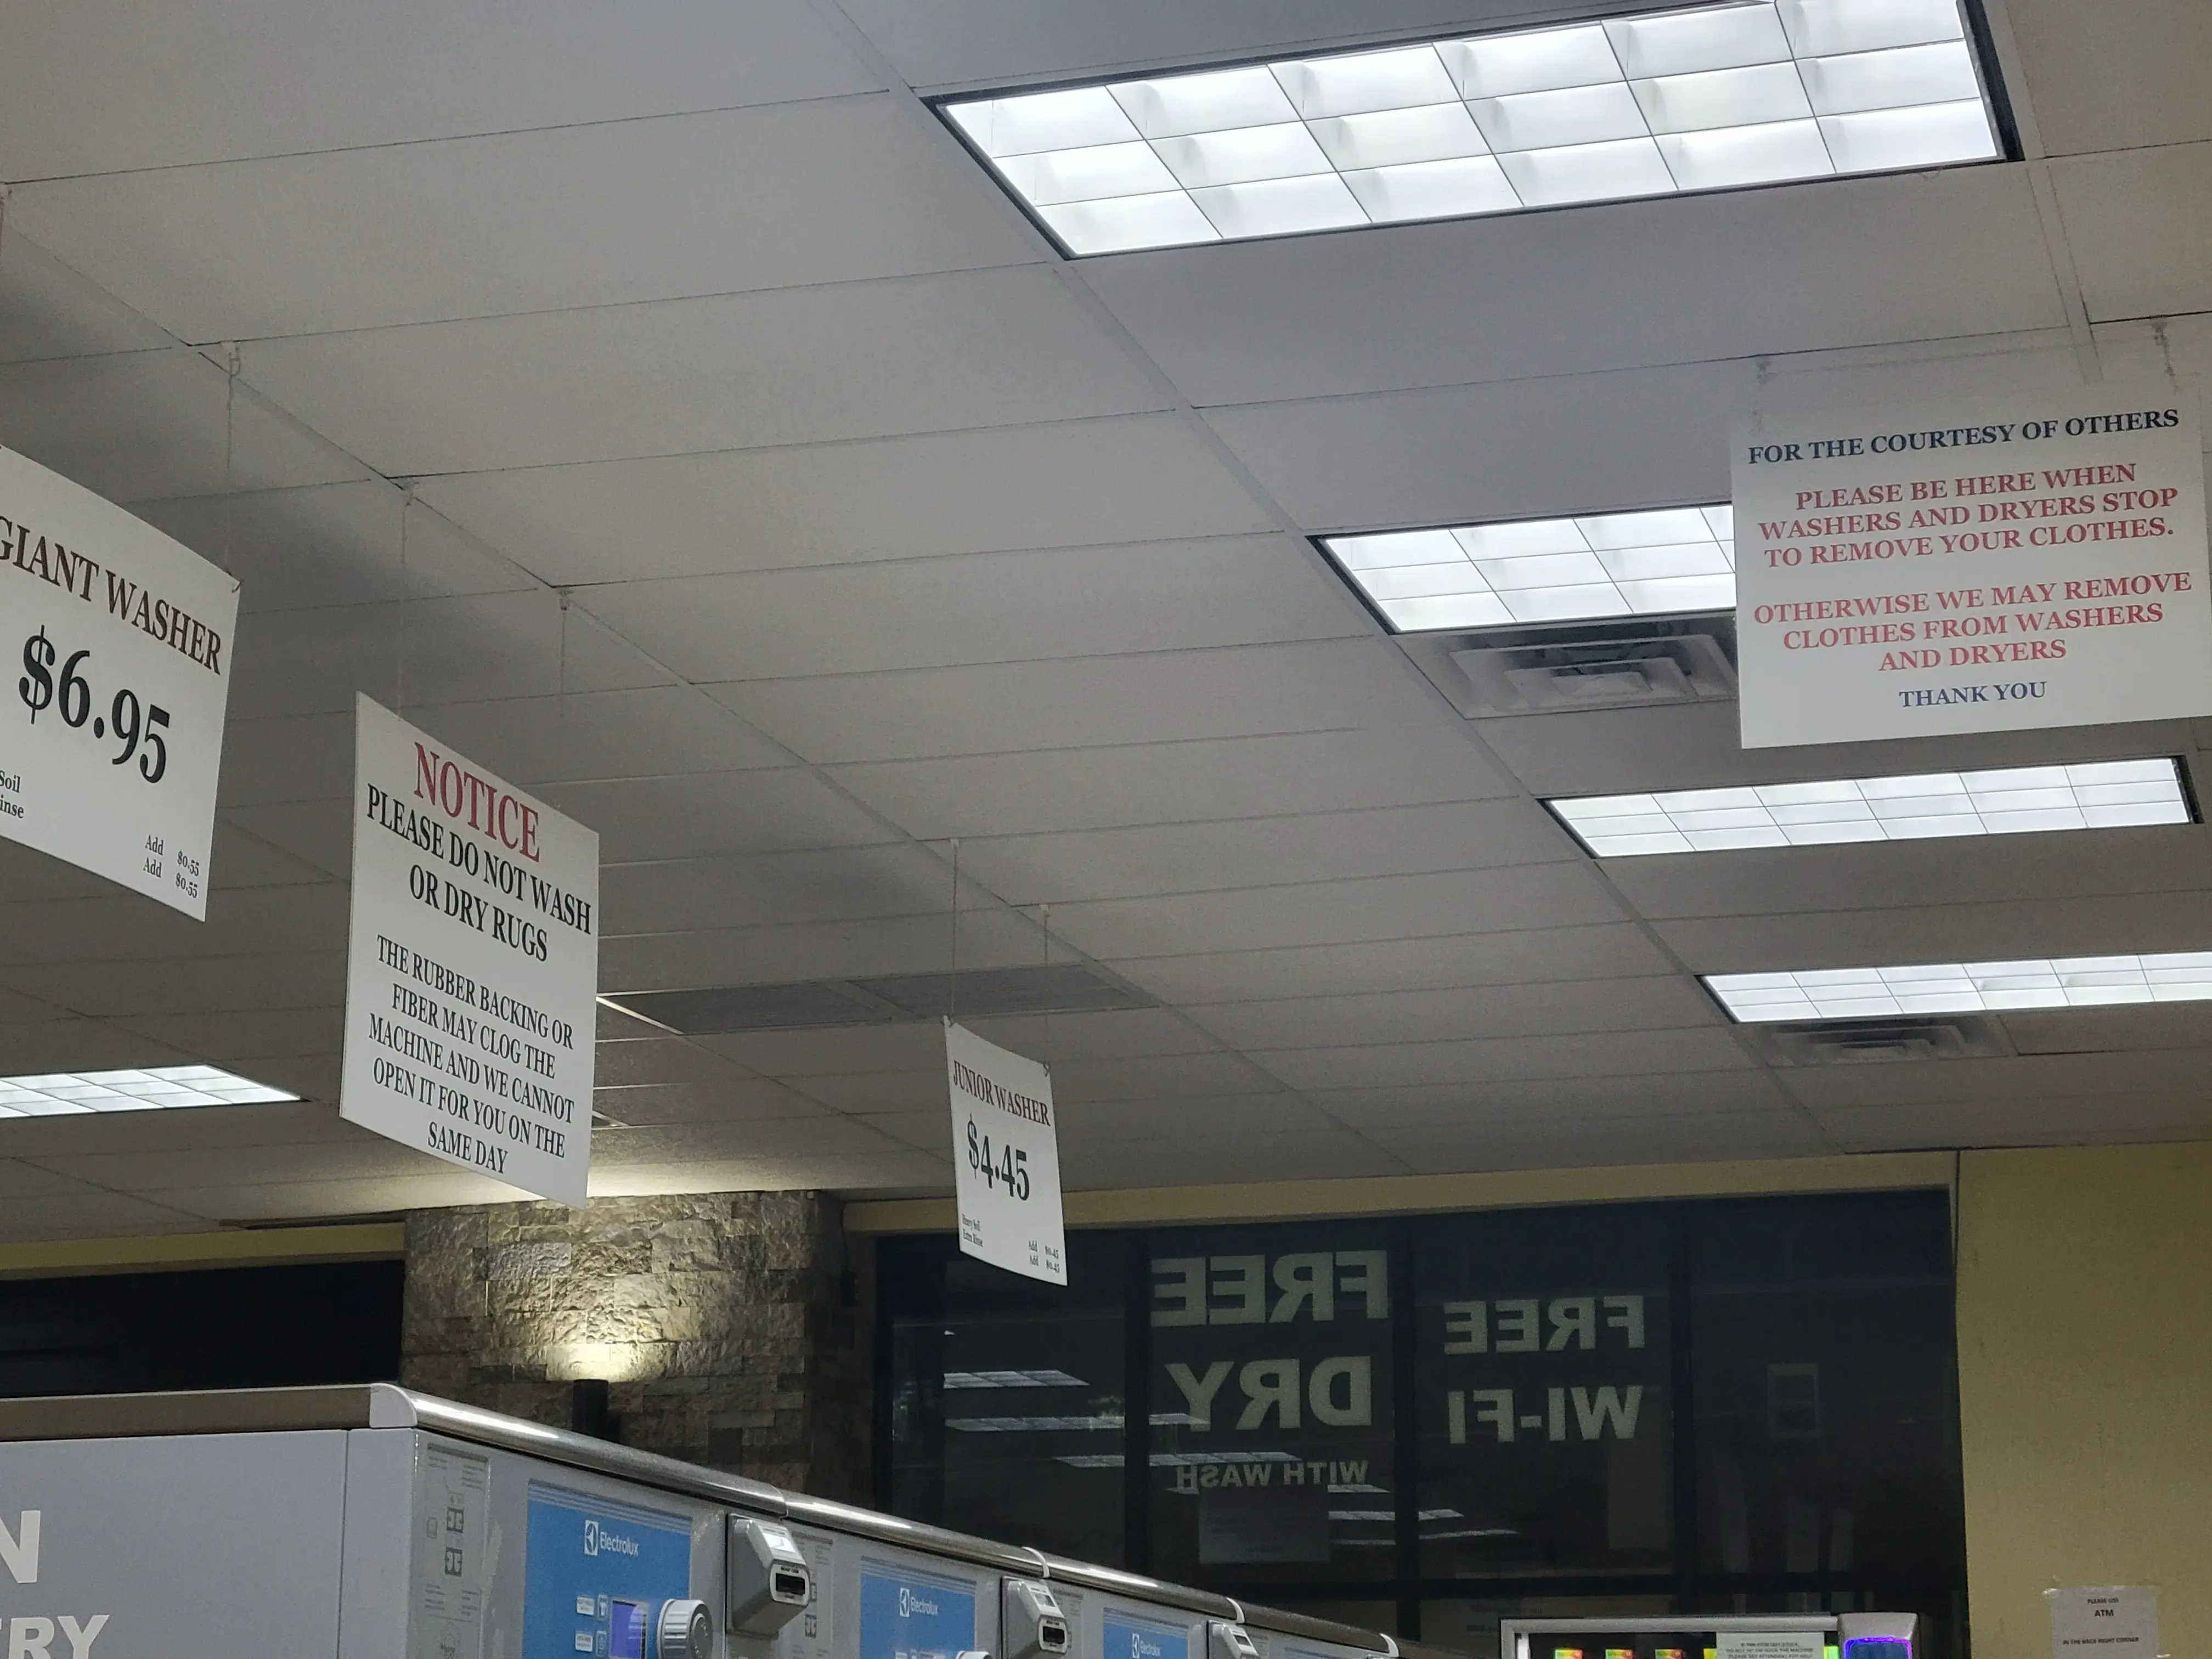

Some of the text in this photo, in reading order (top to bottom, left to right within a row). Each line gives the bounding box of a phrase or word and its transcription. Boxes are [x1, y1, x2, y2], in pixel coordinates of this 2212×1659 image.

[1748, 409, 2179, 464] FOR THE COURTESY OF OTHERS
[1796, 462, 2137, 510] PLEASE BE HERE WHEN
[1758, 488, 2178, 540] WASHERS AND DRYERS STOP
[1764, 517, 2174, 567] TO REMOVE YOUR CLOTHES.
[105, 569, 221, 676] WASHER
[1754, 572, 2192, 624] OTHERWISE WE MAY REMOVE
[1784, 602, 2163, 650] CLOTHES FROM WASHERS
[1878, 639, 2067, 672] AND DRYERS
[19, 624, 170, 783] $6.95
[1899, 681, 2047, 707] THANK YOU
[414, 741, 540, 863] NOTICE
[143, 857, 162, 878] Add
[175, 872, 198, 899] $0.55
[145, 834, 164, 856] Add
[177, 850, 200, 877] $0.55
[366, 783, 591, 935] PLEASE DO NOT WASH
[410, 864, 547, 962] OR DRY RUGS
[377, 934, 573, 1050] THE RUBBER BACKING OR
[392, 983, 555, 1079] FIBER MAY CLOG THE
[369, 1013, 574, 1124] MACHINE AND WE CANNOT
[953, 1060, 1051, 1127] JUNIOR WASHER
[374, 1057, 565, 1159] OPEN IT FOR YOU ON THE
[428, 1121, 508, 1174] SAME DAY
[967, 1113, 1030, 1201] $4.45
[600, 1531, 639, 1556] Electrolux
[0, 1615, 110, 1659] RY
[2094, 1609, 2114, 1617] ATM
